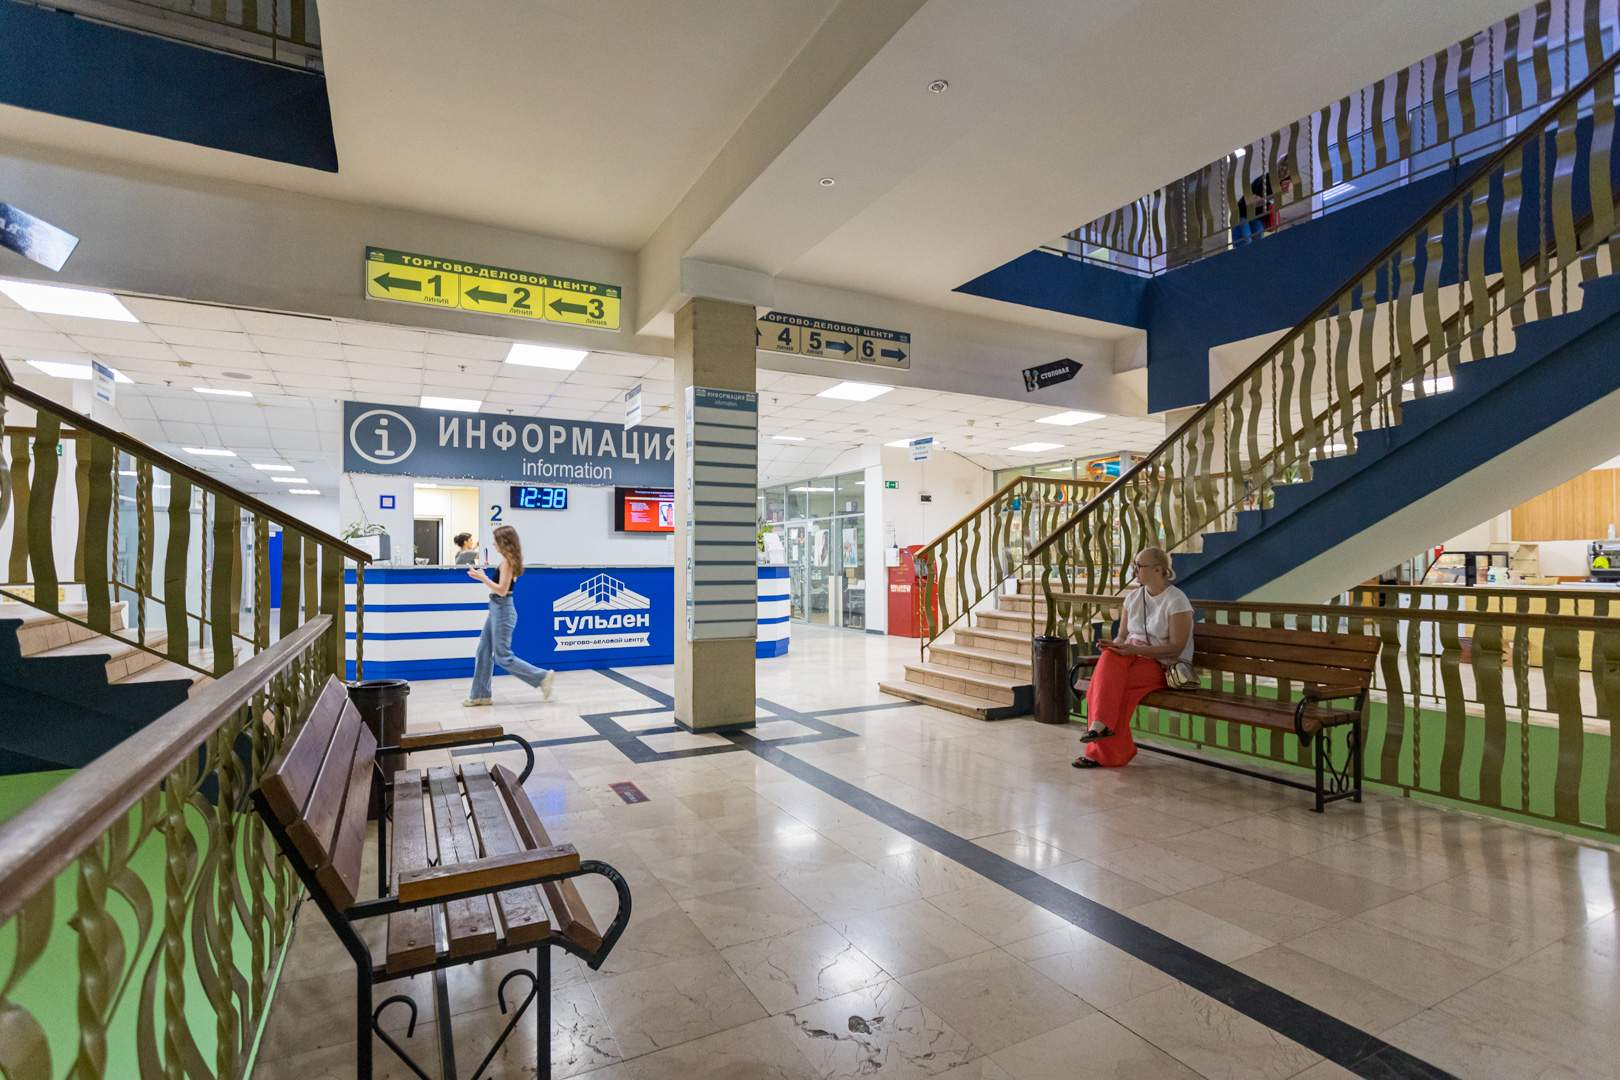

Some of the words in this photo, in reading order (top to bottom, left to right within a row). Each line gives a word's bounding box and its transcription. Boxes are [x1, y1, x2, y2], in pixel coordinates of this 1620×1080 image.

[402, 255, 548, 285] ТОРГОВО-ДЕЛОВОЙ
[553, 279, 597, 292] ЦЕНТР
[427, 274, 442, 297] 1
[512, 287, 531, 309] 2
[588, 298, 604, 319] 3
[778, 327, 792, 346] 4
[809, 331, 822, 350] 5
[863, 327, 894, 339] ЦЕНТР
[862, 339, 874, 357] 6
[522, 458, 612, 480] information
[520, 487, 566, 509] 12:38
[490, 504, 503, 522] 2
[553, 613, 650, 634] гульден
[560, 637, 623, 647] торгово-деловой
